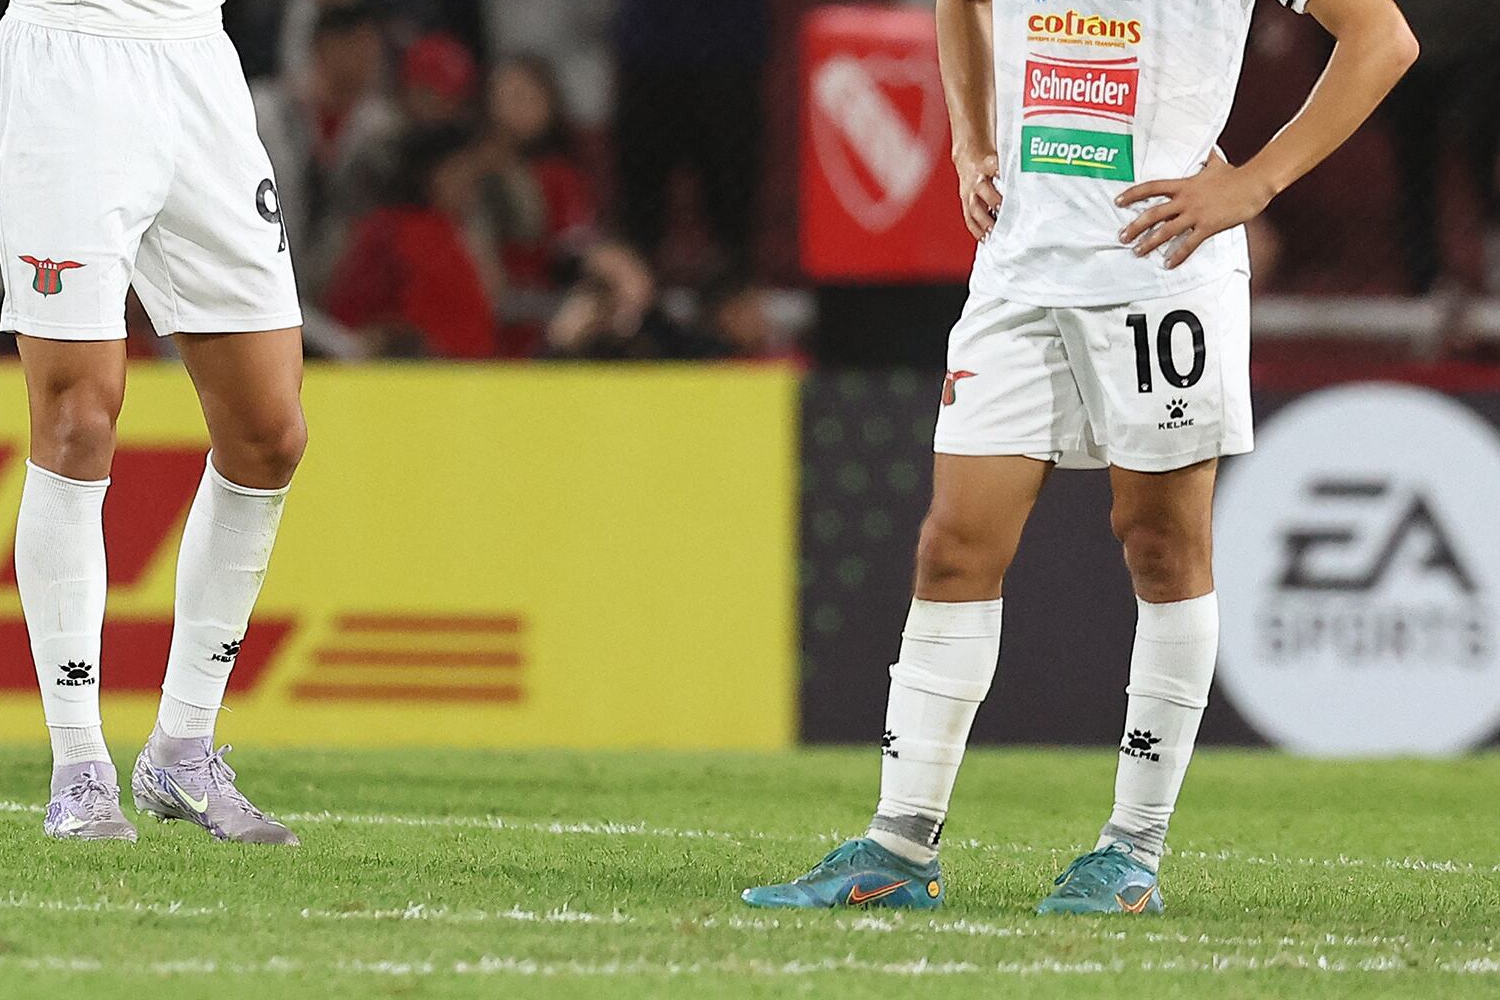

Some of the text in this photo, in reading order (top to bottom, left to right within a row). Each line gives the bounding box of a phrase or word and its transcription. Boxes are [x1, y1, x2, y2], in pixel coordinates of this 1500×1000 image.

[1028, 10, 1141, 44] cotrans
[1030, 68, 1130, 106] Schneider
[1030, 137, 1119, 165] Europcar
[256, 178, 286, 253] 9
[1125, 309, 1206, 393] 10
[1158, 418, 1195, 430] KELME
[1278, 479, 1479, 593] EA
